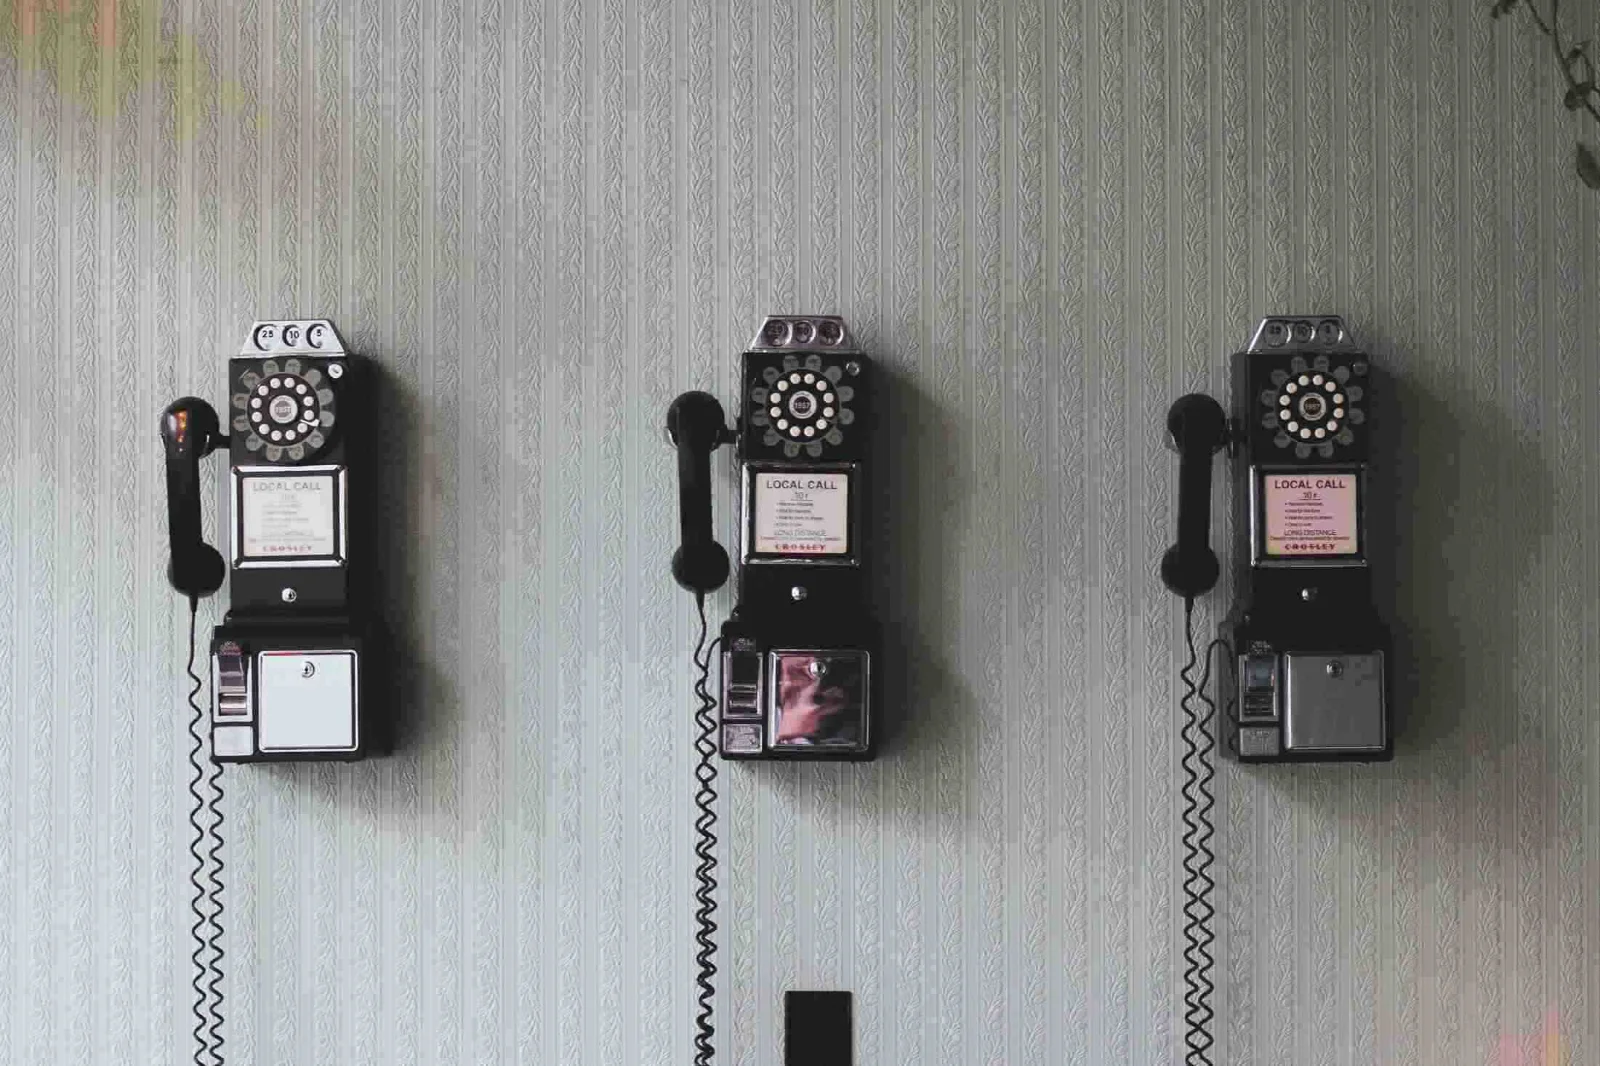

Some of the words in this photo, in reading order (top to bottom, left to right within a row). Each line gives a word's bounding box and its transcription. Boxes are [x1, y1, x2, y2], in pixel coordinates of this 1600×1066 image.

[262, 330, 274, 338] 25
[289, 331, 300, 339] 10
[316, 329, 322, 337] 5
[253, 482, 291, 492] LOCAL
[293, 482, 321, 491] CALL
[766, 480, 804, 489] LOCAL
[807, 480, 838, 490] CALL
[1274, 480, 1313, 489] LOCAL
[1315, 480, 1347, 489] CALL
[775, 543, 827, 551] CROSLEY
[1284, 543, 1336, 551] CROSLEY
